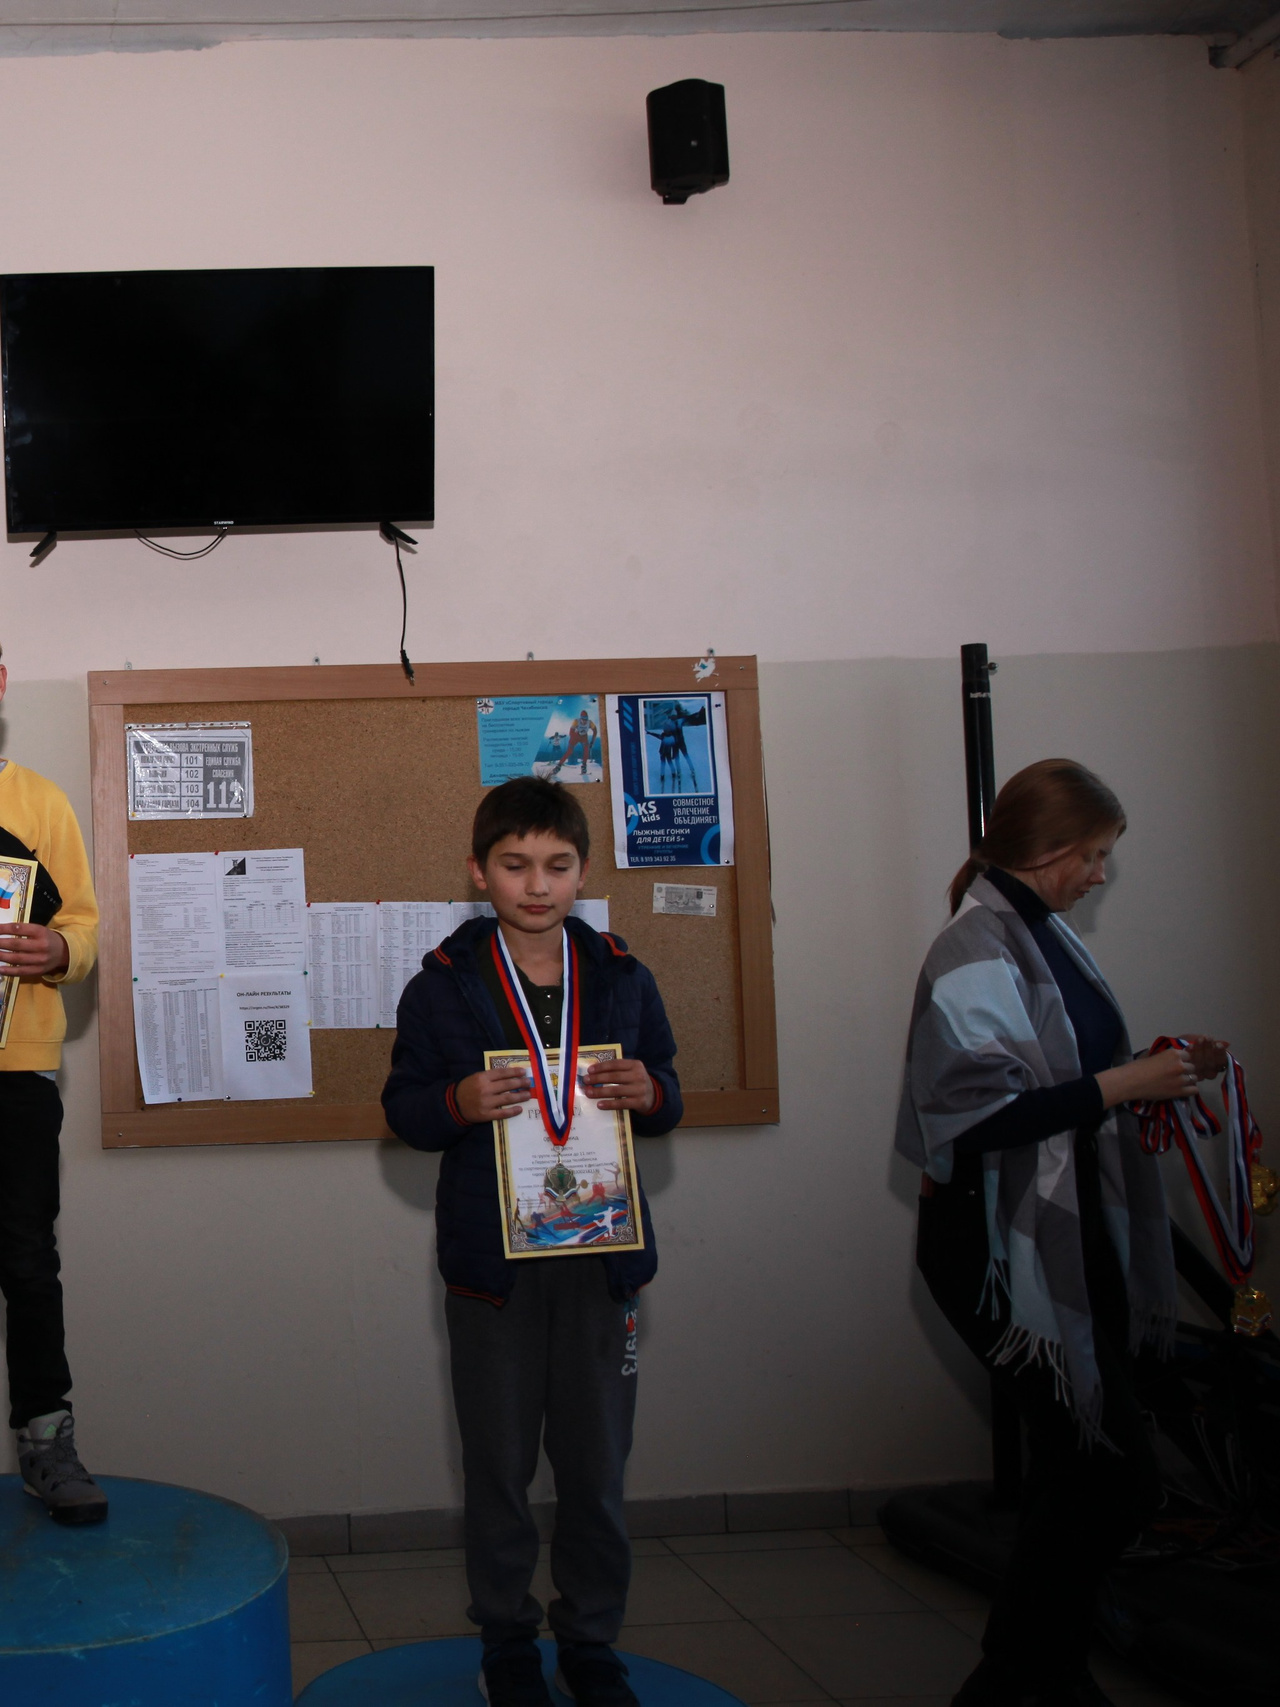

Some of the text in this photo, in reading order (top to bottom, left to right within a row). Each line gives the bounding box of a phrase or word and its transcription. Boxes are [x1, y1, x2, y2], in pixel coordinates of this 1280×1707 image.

[185, 756, 198, 764] 101
[185, 770, 199, 778] 102
[186, 785, 199, 793] 103
[206, 781, 242, 808] 112
[185, 800, 200, 808] 104
[672, 798, 714, 807] СОВМЕСТНОЕ
[626, 801, 657, 818] AKS
[673, 807, 710, 816] УВЛЕЧЕНИЕ
[641, 813, 660, 823] kids
[674, 816, 718, 825] ОБЪЕДИНЯЕТ!
